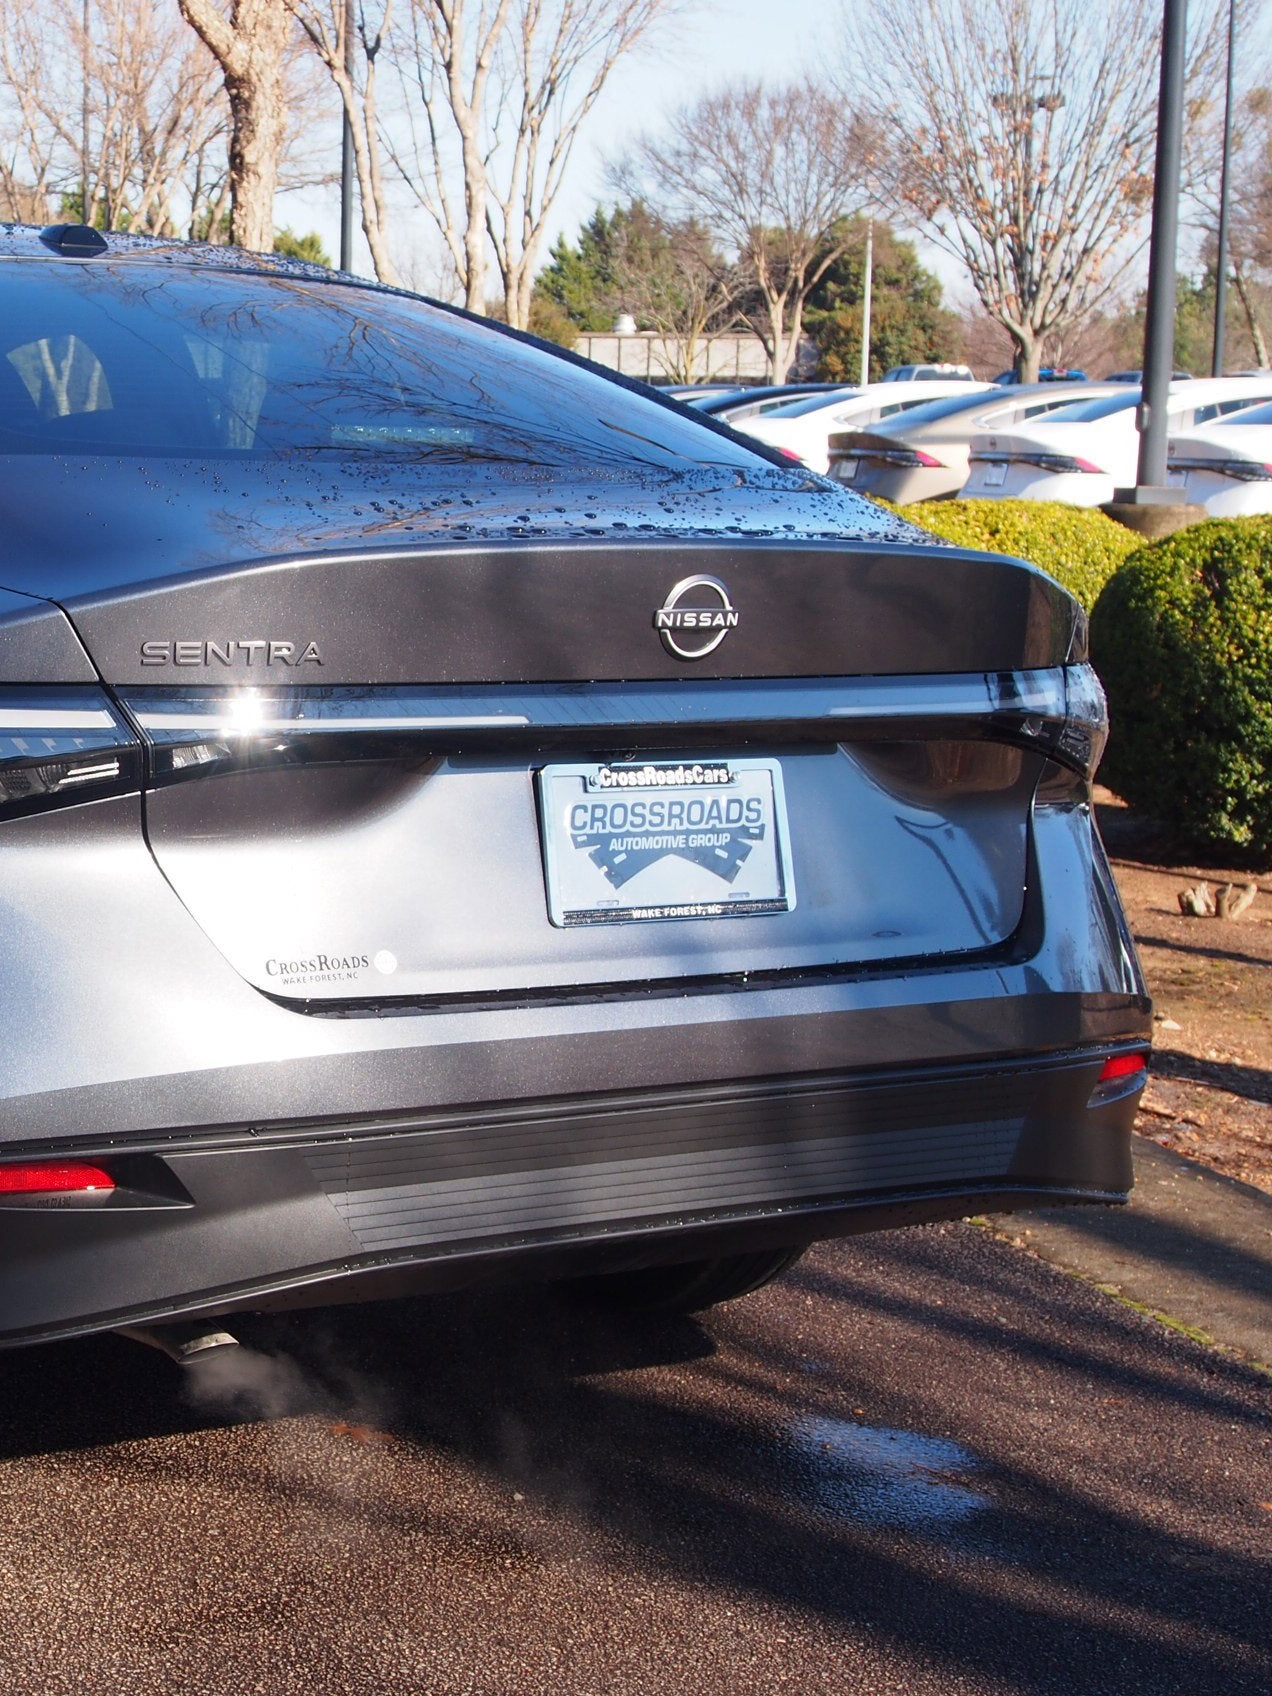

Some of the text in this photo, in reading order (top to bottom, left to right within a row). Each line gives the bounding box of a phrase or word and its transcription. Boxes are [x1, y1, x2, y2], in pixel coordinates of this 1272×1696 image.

[657, 612, 739, 627] NISSAN
[140, 641, 325, 667] SENTRA
[599, 765, 728, 788] CrossRoadsCars
[570, 797, 762, 832] CROSSROADS
[609, 833, 731, 851] AUTOMOTIVE GROUP
[632, 909, 662, 918] WAKE
[708, 904, 722, 914] NC
[281, 976, 307, 985] WAKE
[346, 971, 358, 980] NC
